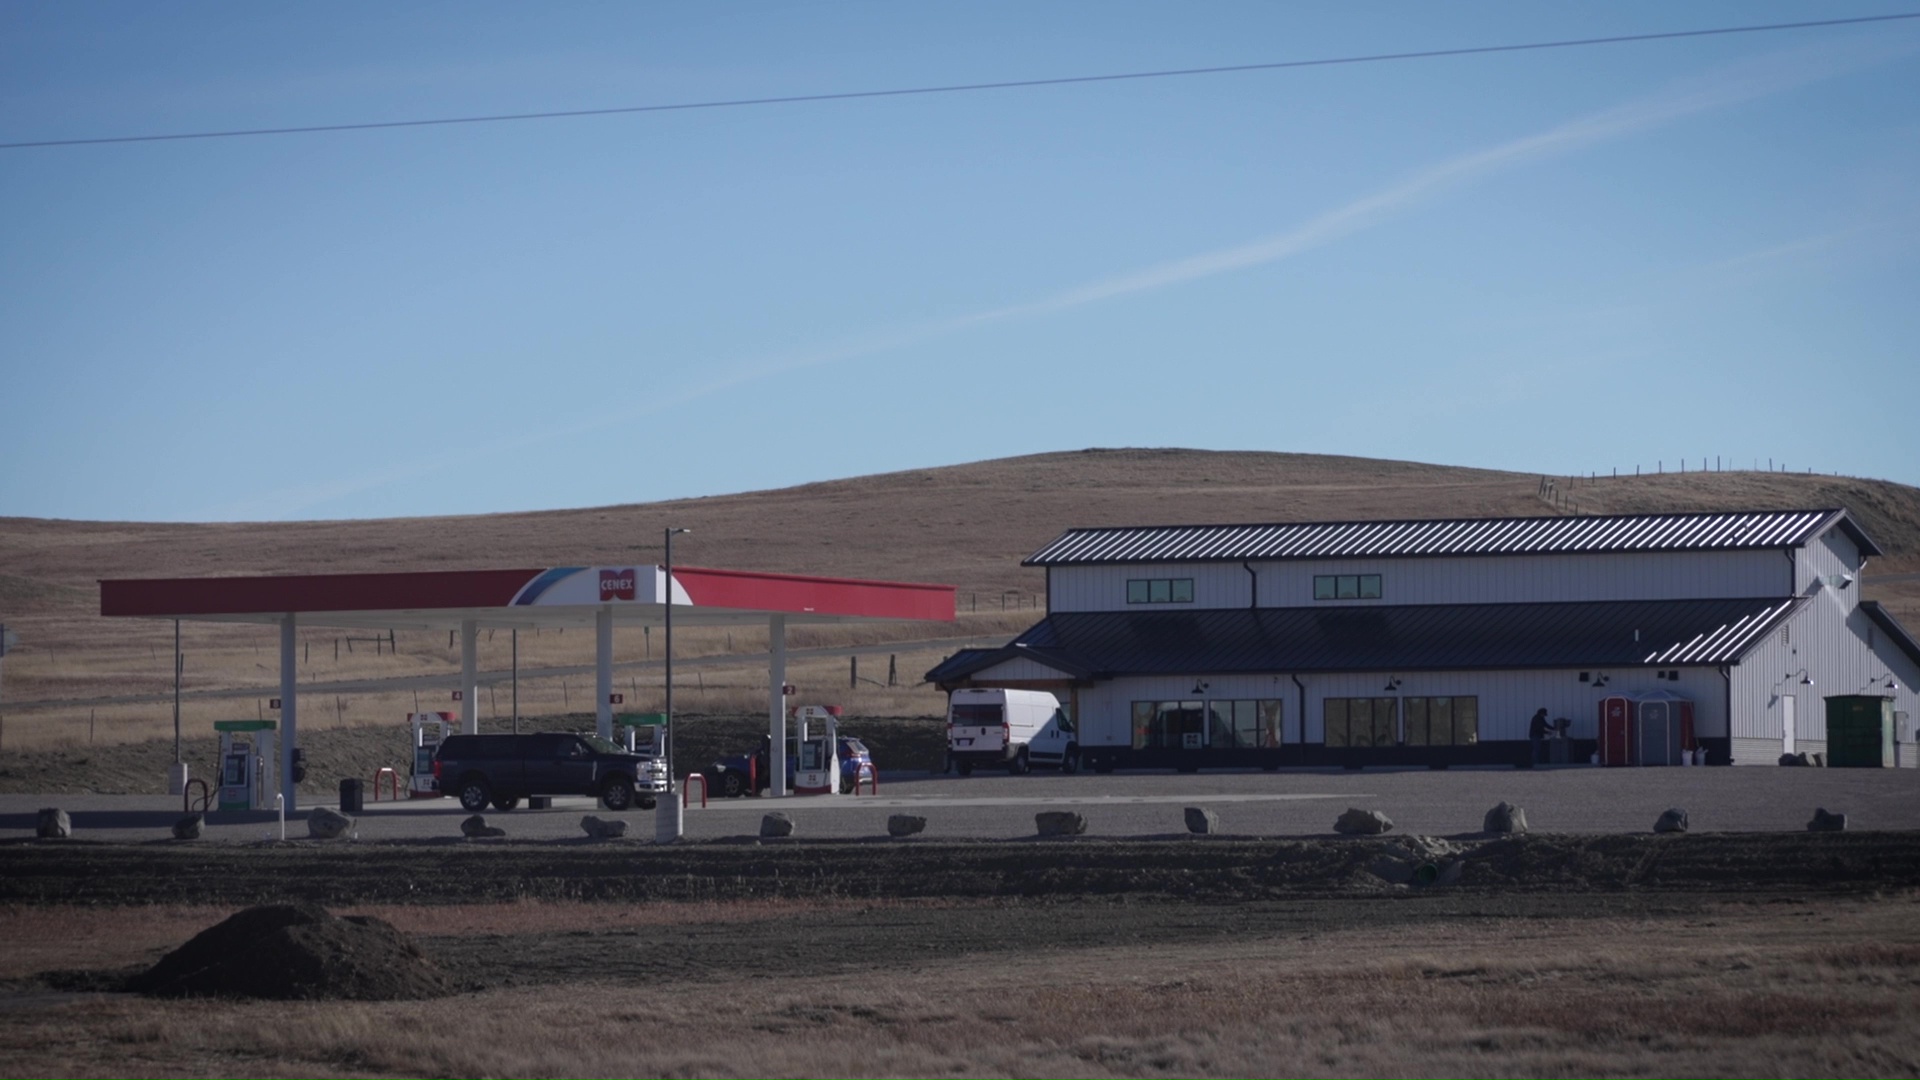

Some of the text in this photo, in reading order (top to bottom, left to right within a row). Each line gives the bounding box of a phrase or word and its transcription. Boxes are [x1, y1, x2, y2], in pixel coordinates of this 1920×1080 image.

[601, 579, 633, 591] CENEX
[787, 686, 792, 695] 2
[455, 692, 460, 700] 4
[614, 694, 620, 703] 6
